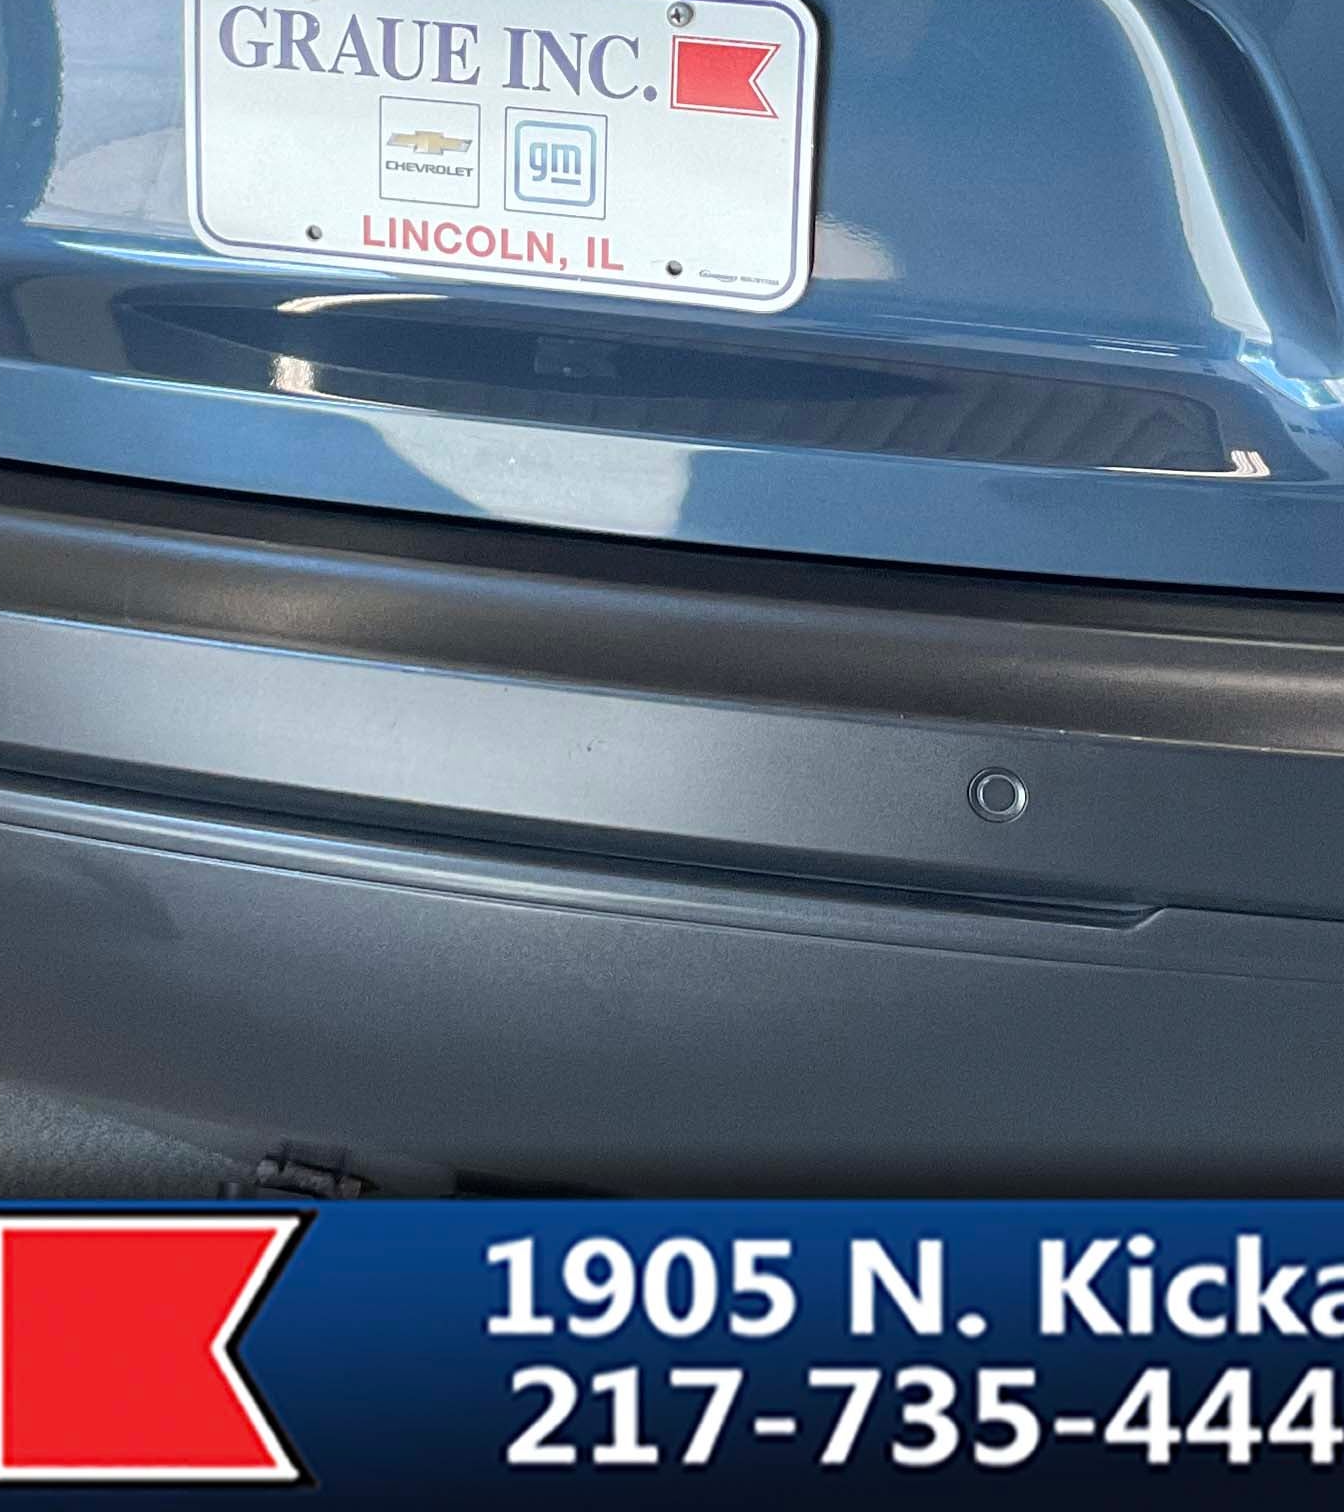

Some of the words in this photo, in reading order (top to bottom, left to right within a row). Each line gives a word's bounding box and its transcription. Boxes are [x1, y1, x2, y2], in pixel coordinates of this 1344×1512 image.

[218, 4, 481, 88] GRAUE
[501, 27, 658, 102] INC.
[385, 159, 473, 178] CHEVROLET
[529, 141, 582, 180] gm
[362, 215, 568, 269] LINCOLN,
[586, 236, 624, 272] IL
